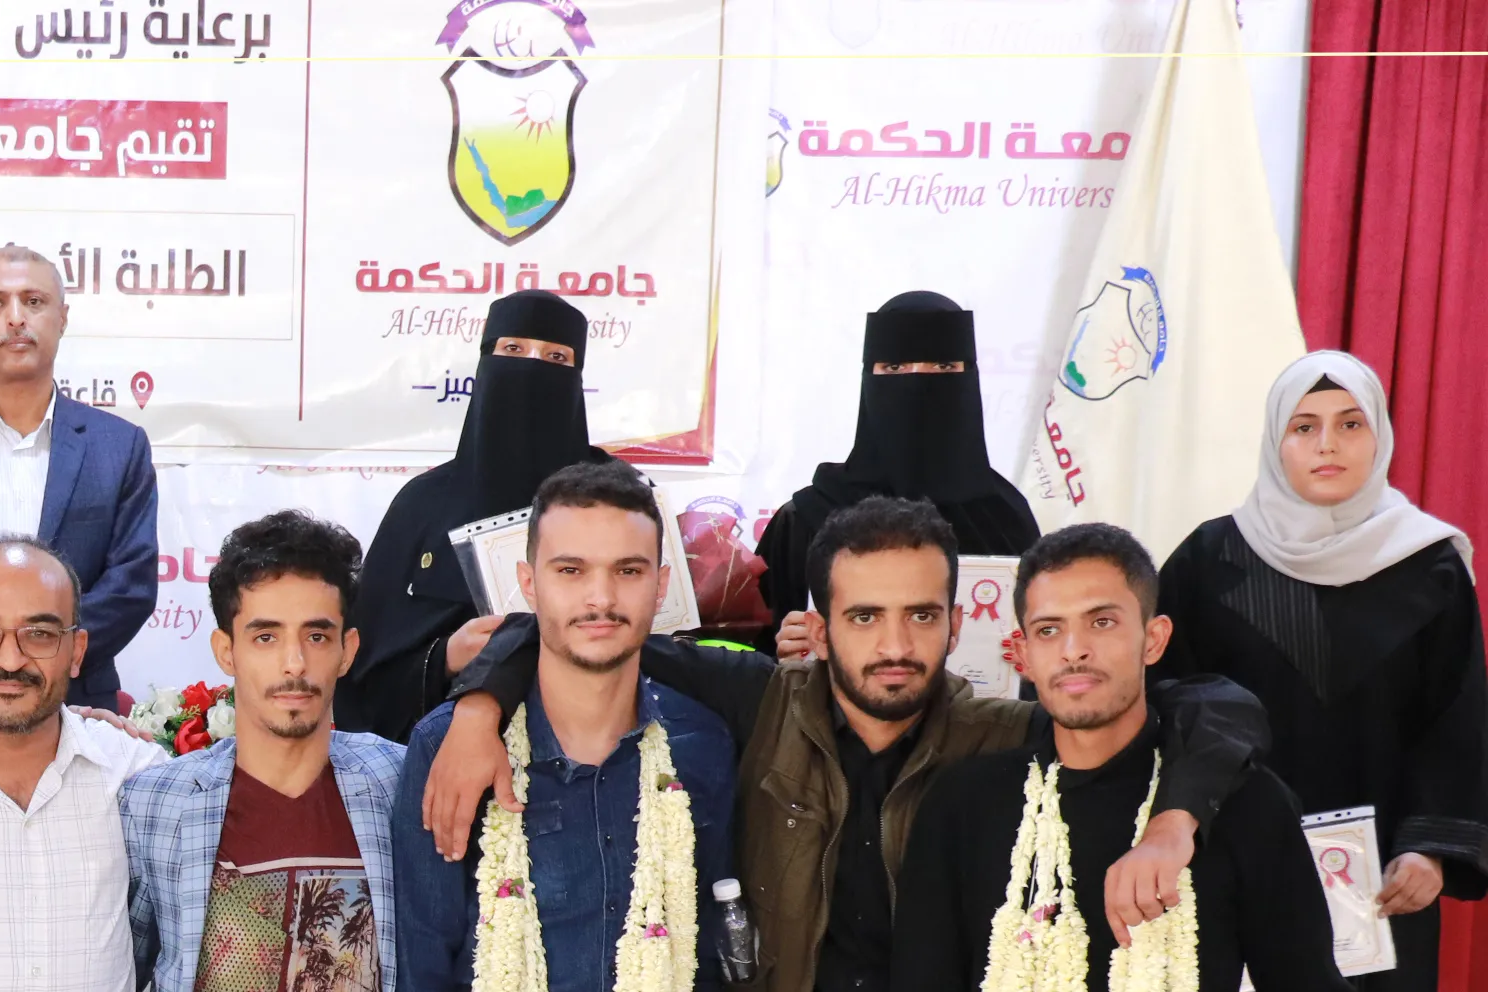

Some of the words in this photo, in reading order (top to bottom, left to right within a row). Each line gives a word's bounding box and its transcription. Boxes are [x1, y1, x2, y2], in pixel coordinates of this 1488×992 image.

[116, 118, 215, 176] تقيم
[798, 120, 991, 159] الحكمة
[831, 172, 986, 214] Al-Hikma
[116, 249, 246, 309] الطلبة
[356, 260, 505, 295] الحكمة
[516, 263, 657, 306] جامعة
